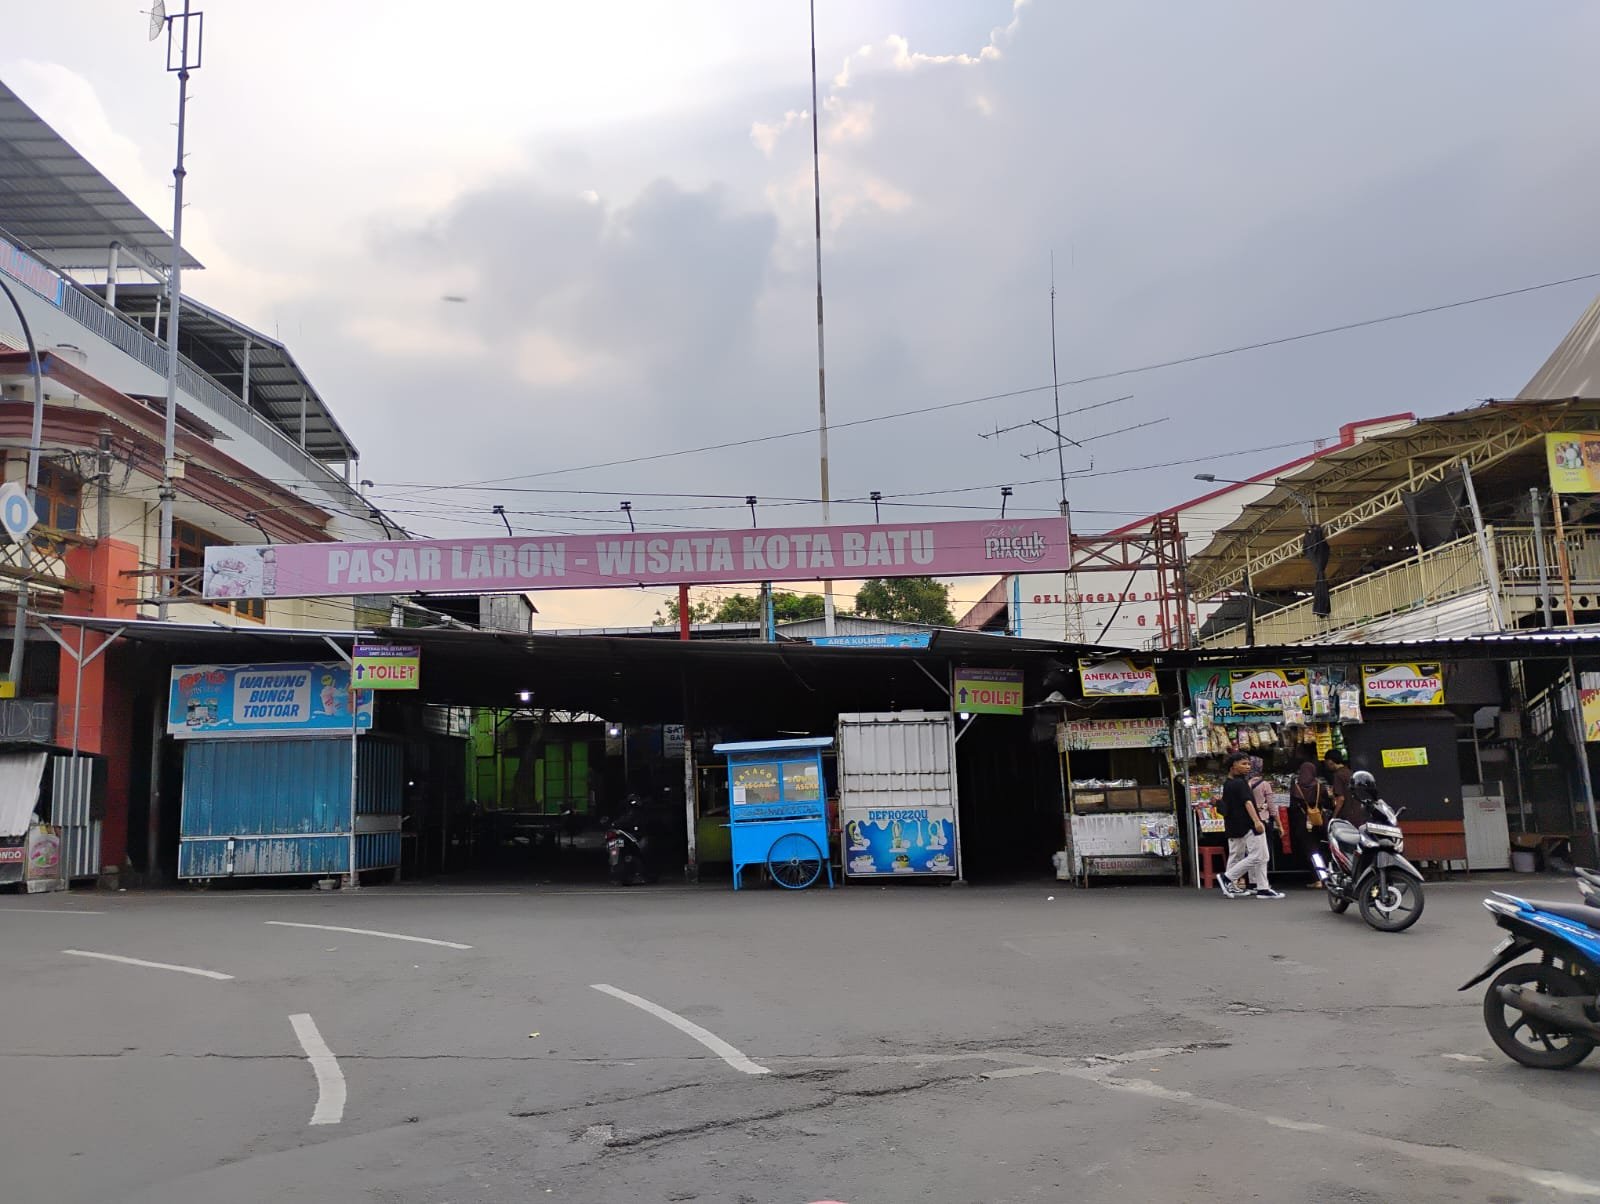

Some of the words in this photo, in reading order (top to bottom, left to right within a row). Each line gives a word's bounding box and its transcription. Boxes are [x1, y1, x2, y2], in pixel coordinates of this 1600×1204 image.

[328, 547, 441, 584] PASAR
[452, 542, 565, 580] LARON
[595, 538, 734, 576] WISATA
[743, 534, 835, 570] KOTA
[842, 530, 934, 567] BATU
[996, 549, 1040, 562] HARUM
[368, 665, 416, 680] TOILET
[1084, 673, 1119, 681] ANEKA
[1120, 672, 1152, 680] TELUR
[239, 675, 306, 689] WARUNG
[1249, 680, 1288, 689] ANEKA
[1368, 680, 1403, 689] CILOK
[1405, 680, 1437, 688] KUAH
[249, 689, 294, 702] BUNGA
[971, 689, 1020, 705] TOILET
[243, 704, 300, 718] TROTOAR
[1070, 721, 1117, 731] ANEKA
[1121, 719, 1164, 729] TELUR
